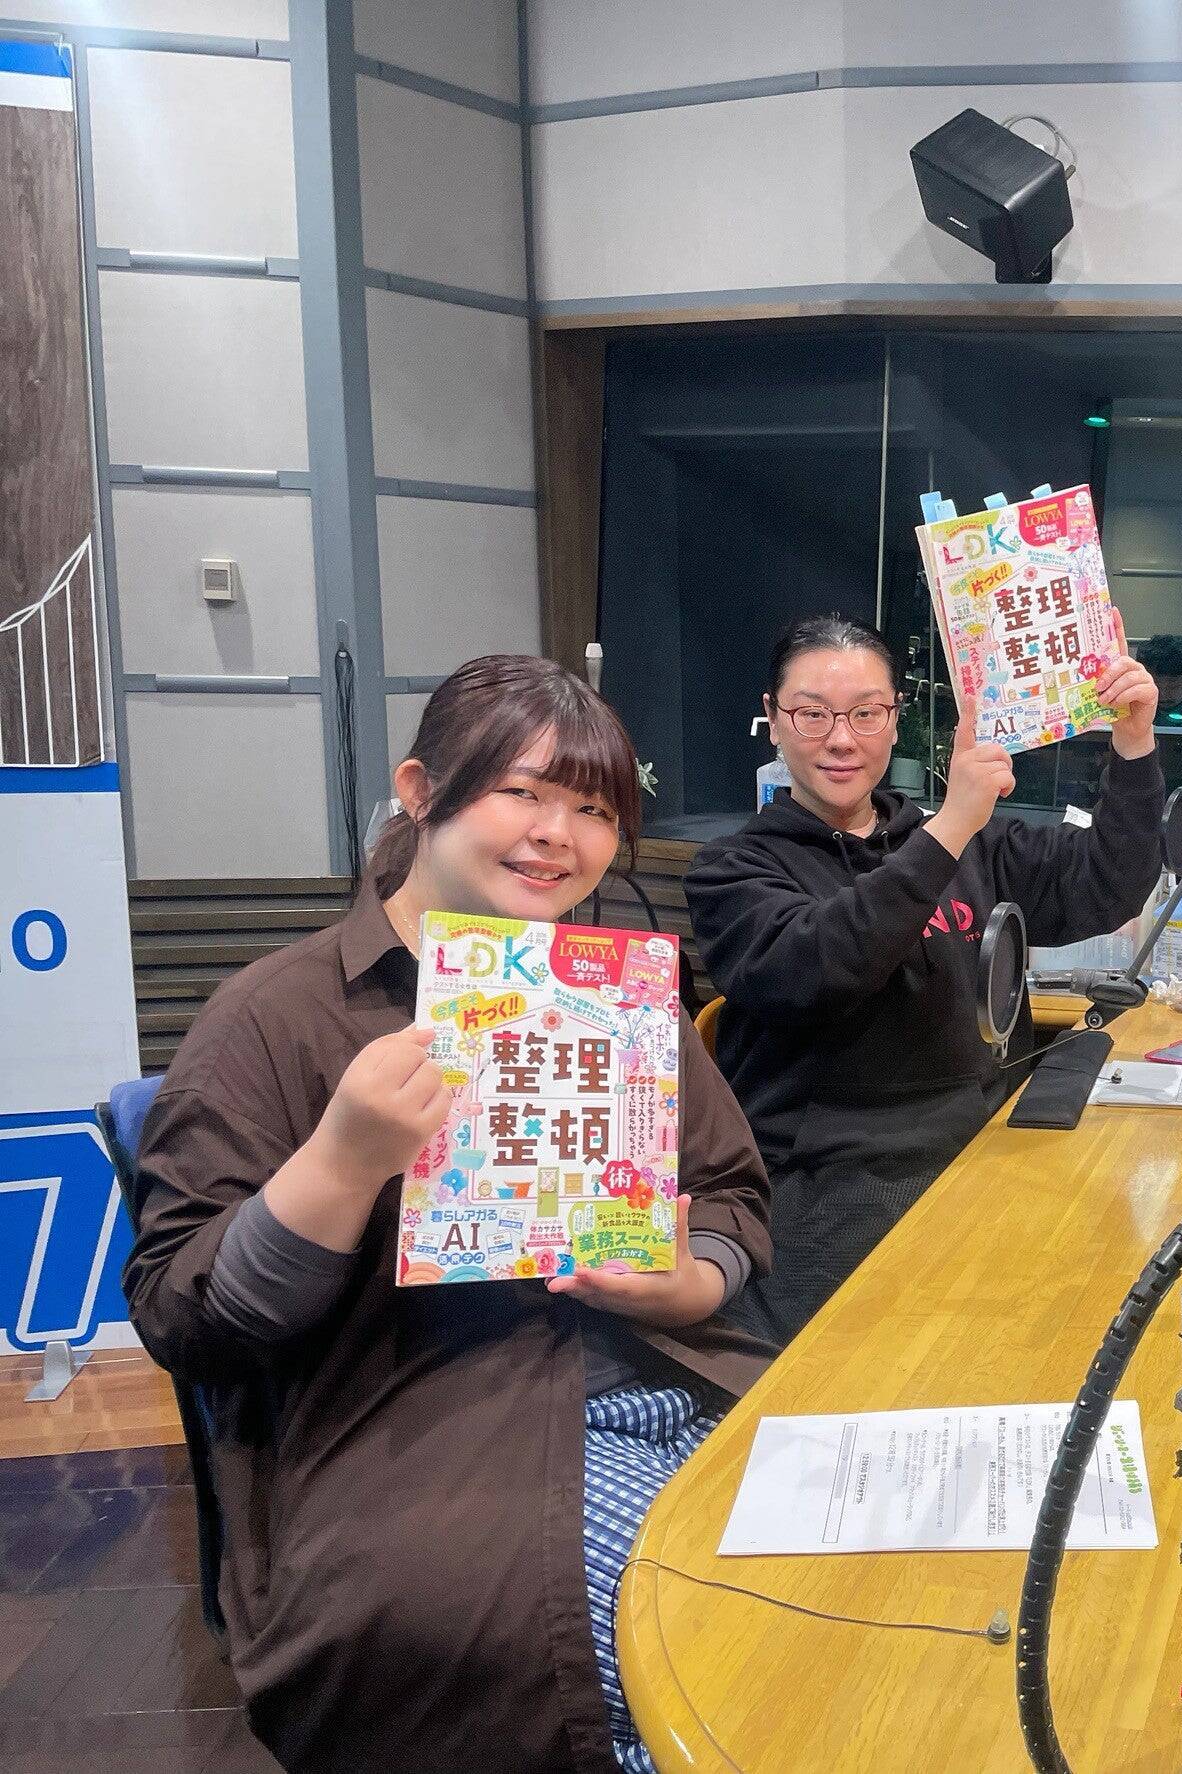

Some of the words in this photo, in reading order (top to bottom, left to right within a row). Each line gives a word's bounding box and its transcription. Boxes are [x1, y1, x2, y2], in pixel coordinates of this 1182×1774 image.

[1024, 510, 1063, 528] LOWYA
[943, 524, 1016, 565] LDK
[994, 576, 1074, 632] 整理
[1003, 623, 1080, 679] 整頓
[993, 717, 1017, 738] AI
[436, 936, 539, 987] LDK
[559, 942, 619, 960] LOWYA
[463, 996, 519, 1031] 片づく!!
[492, 1031, 611, 1094] 整理
[489, 1103, 611, 1166] 整頓
[609, 1166, 632, 1188] 術
[431, 1209, 498, 1222] 暮らしアガる
[442, 1223, 480, 1251] AI
